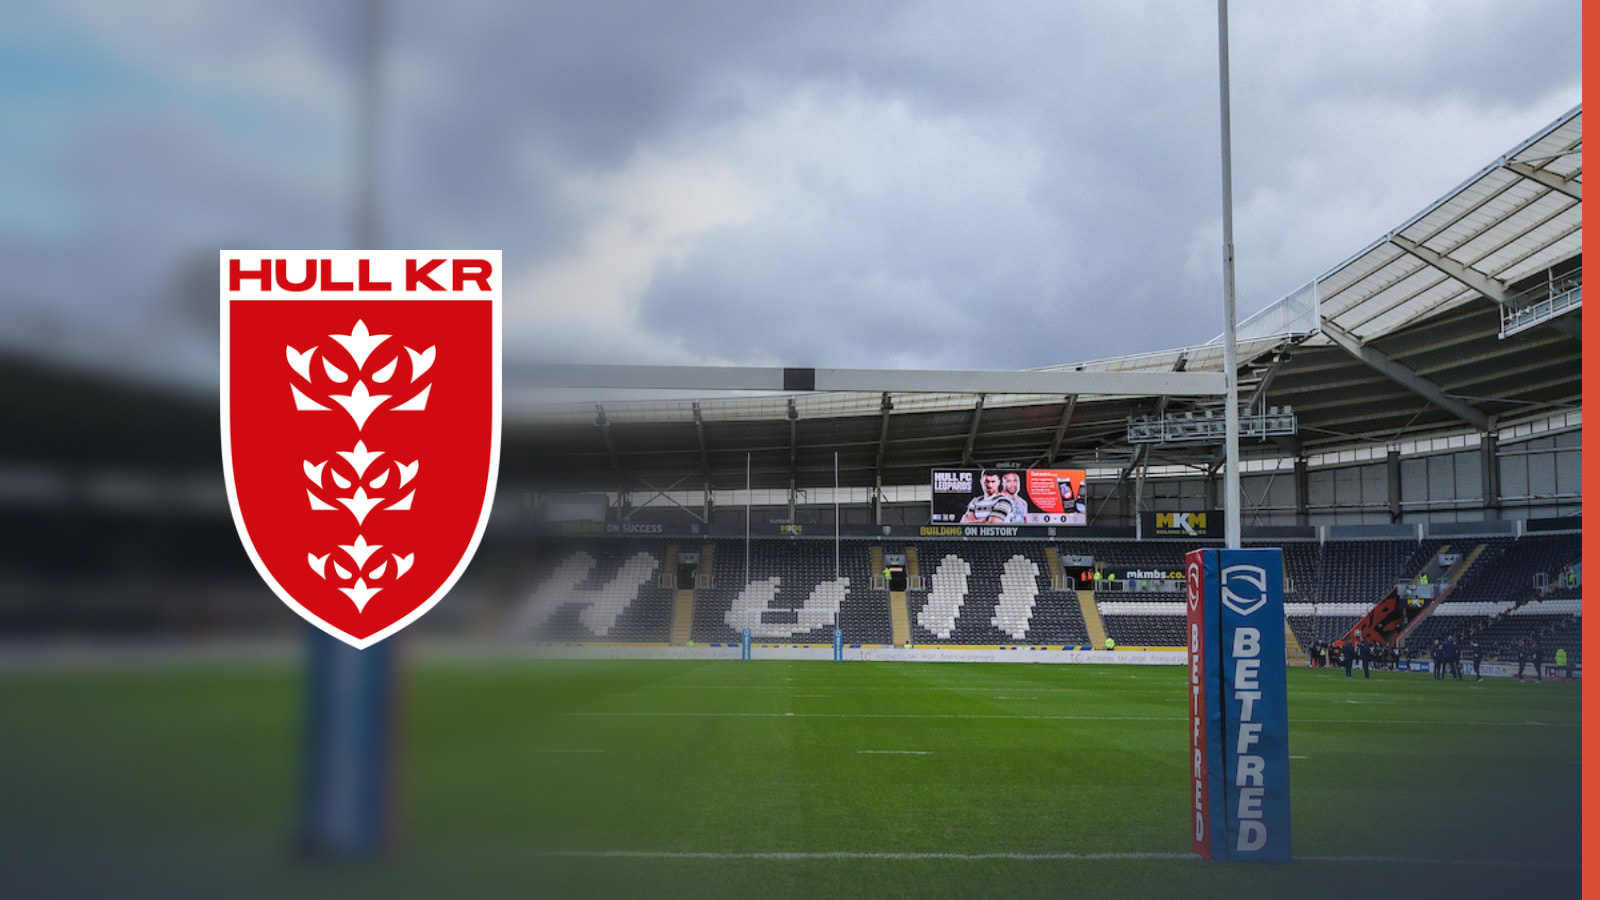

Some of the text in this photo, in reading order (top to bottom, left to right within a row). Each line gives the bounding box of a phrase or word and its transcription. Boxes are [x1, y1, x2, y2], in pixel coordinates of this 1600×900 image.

[934, 472, 972, 482] HULL FC
[934, 481, 972, 491] LEOPARDS
[561, 523, 662, 533] UILDING ON SUCCESS
[1156, 512, 1206, 536] MKM
[920, 526, 1018, 536] BUILDING ON HISTORY
[1191, 623, 1204, 842] BETFRED
[1232, 627, 1267, 851] BETFRED
